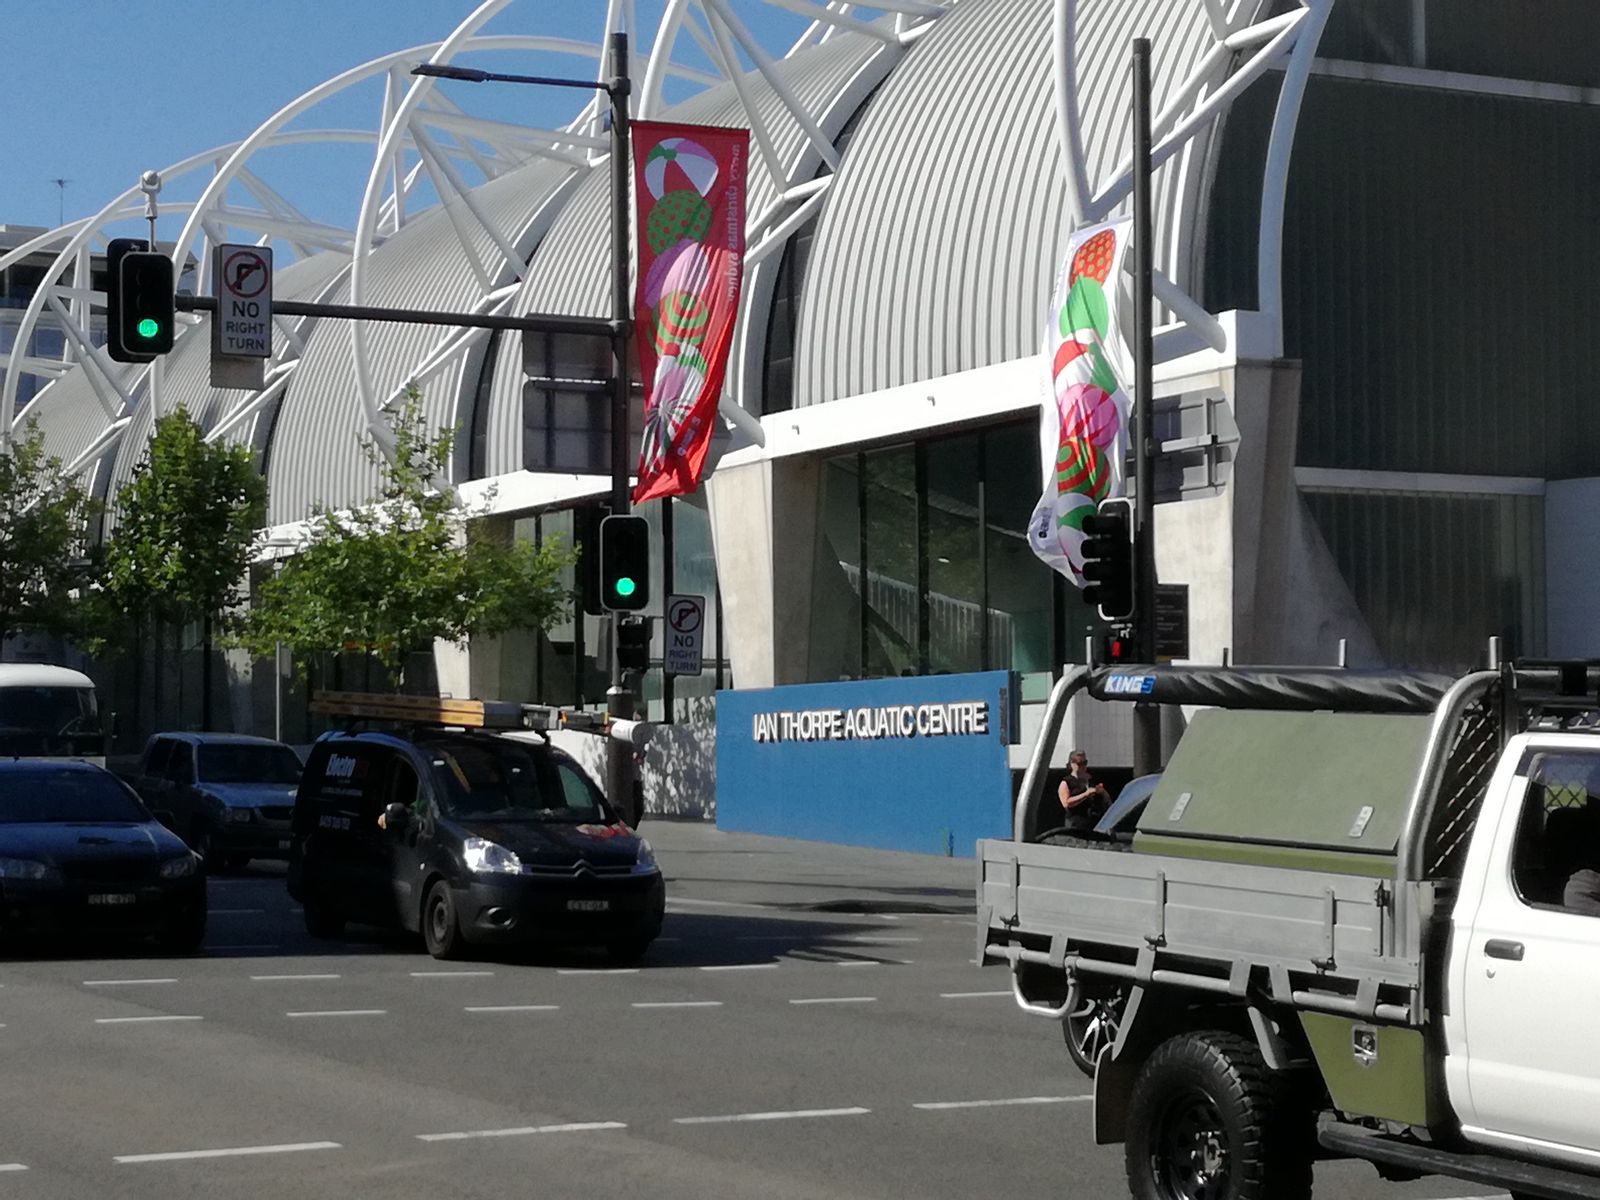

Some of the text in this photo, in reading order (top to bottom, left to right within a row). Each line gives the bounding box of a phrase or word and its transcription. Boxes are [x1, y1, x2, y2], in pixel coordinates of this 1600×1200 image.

[232, 301, 260, 318] NO
[225, 321, 265, 335] RIGHT
[227, 337, 265, 351] TURN
[674, 635, 694, 648] NO
[669, 649, 698, 659] RIGHT
[669, 661, 698, 671] TURN
[1104, 675, 1157, 694] KINGS
[753, 701, 987, 742] IAN THORPE AQUATIC CENTRE
